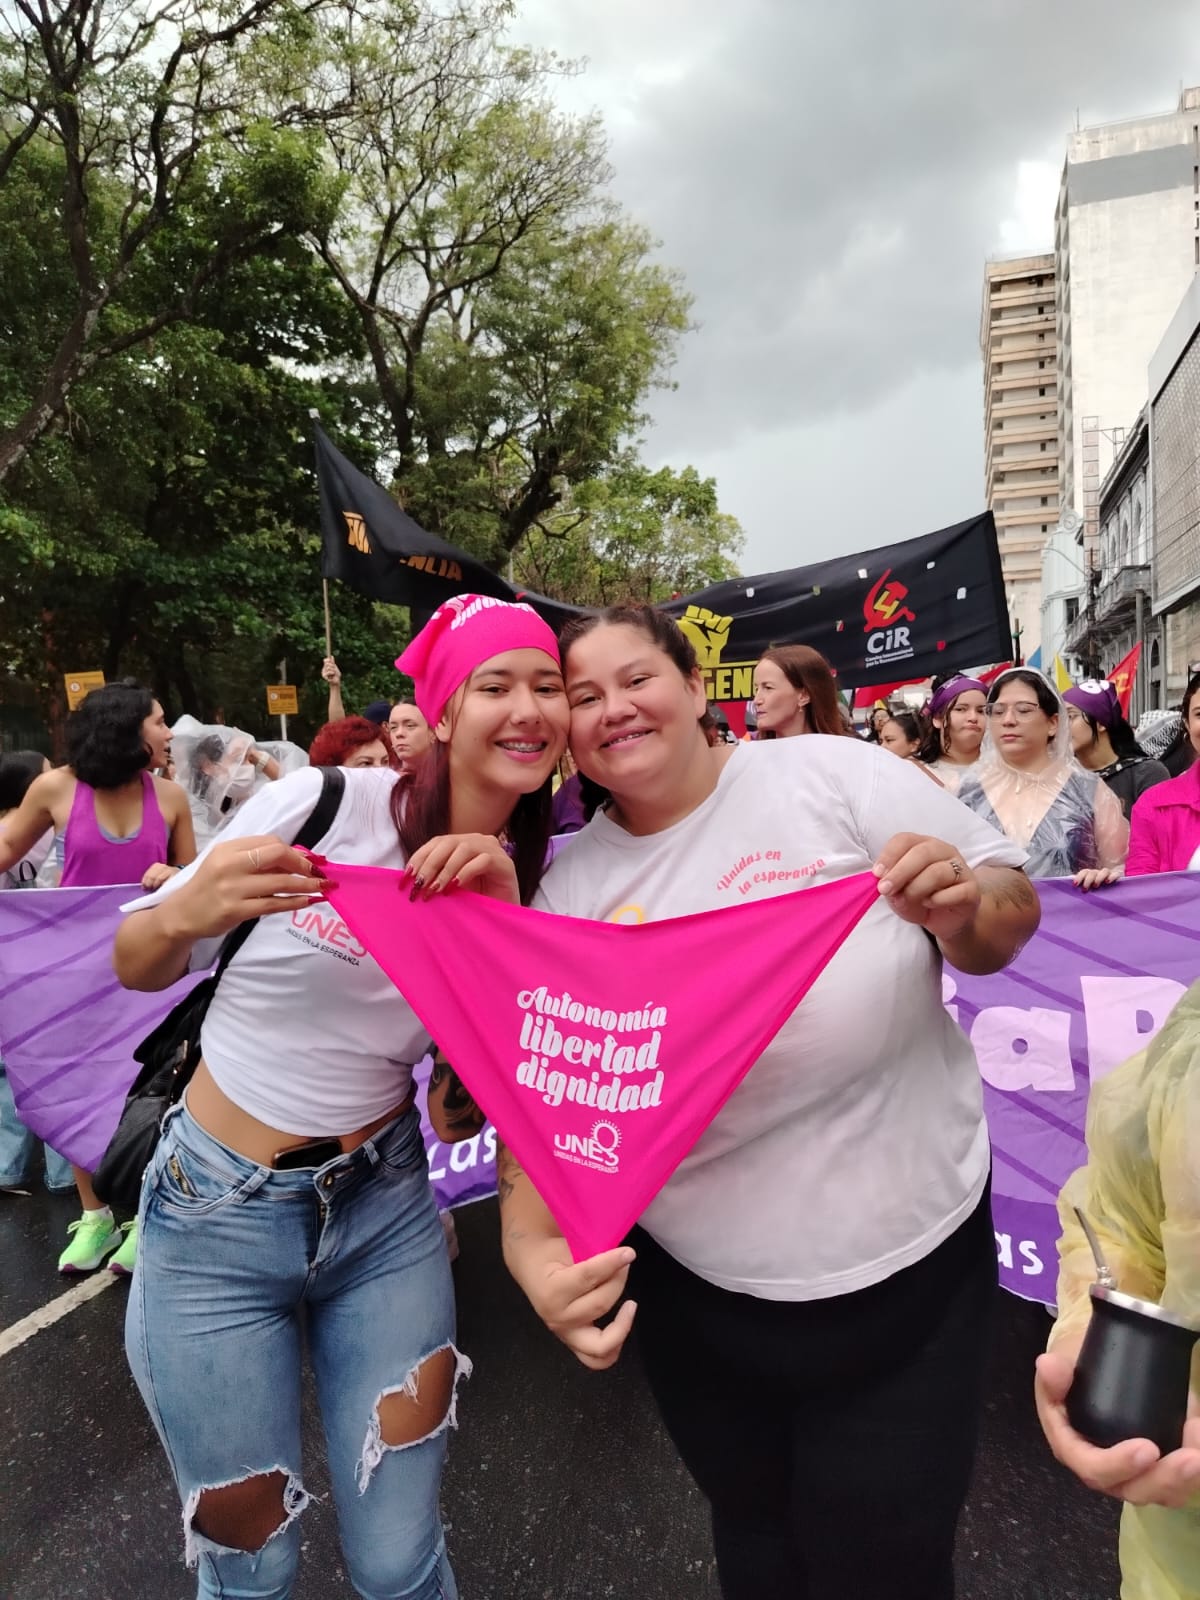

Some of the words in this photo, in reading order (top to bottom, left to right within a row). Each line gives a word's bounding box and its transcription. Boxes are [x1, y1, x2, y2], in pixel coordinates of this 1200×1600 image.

[717, 851, 762, 890] Unidas
[764, 850, 782, 861] en
[738, 880, 752, 895] la
[752, 858, 826, 884] esperanza
[516, 986, 668, 1033] Autonomía
[519, 1012, 662, 1075] libertad
[515, 1054, 665, 1113] dignidad
[554, 1127, 620, 1167] UNES
